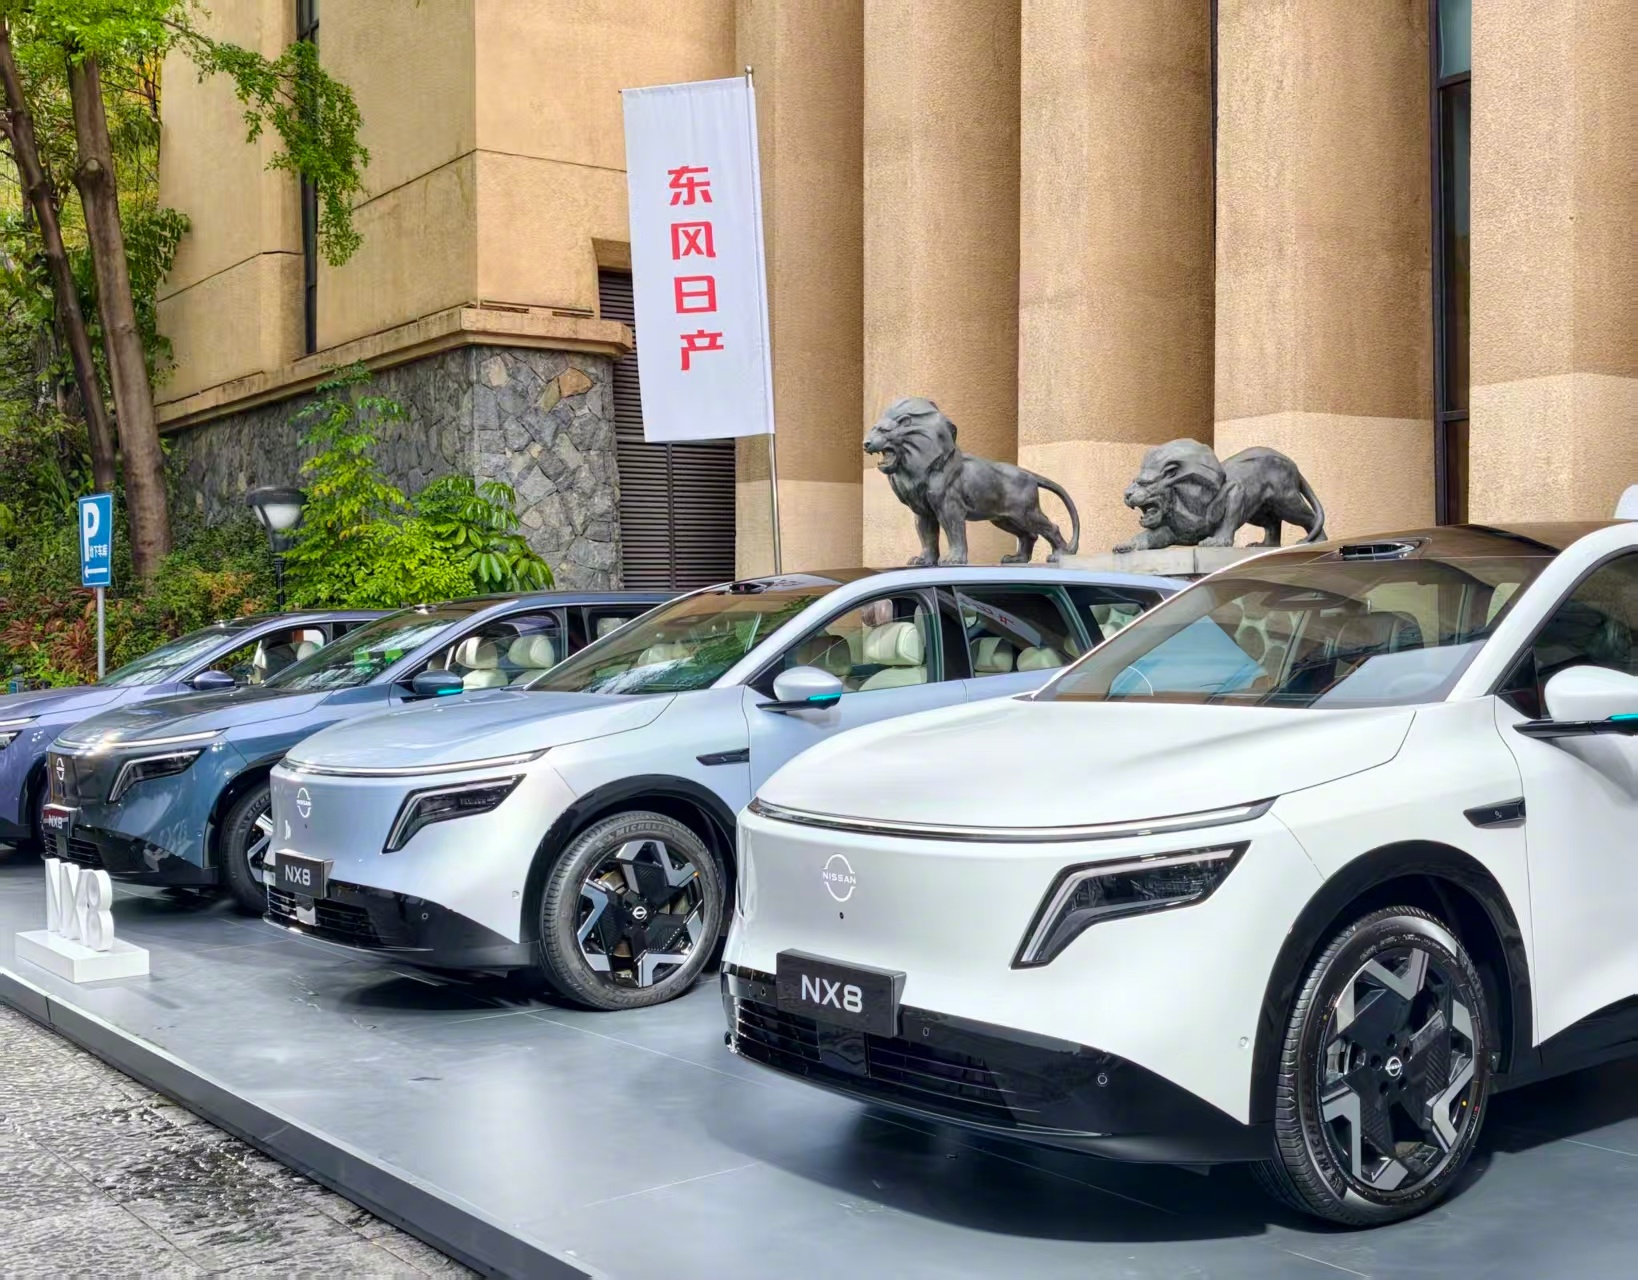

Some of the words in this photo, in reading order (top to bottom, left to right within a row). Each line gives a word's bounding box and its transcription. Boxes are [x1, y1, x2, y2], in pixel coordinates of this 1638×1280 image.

[667, 165, 725, 371] 东风日产
[83, 502, 100, 562] P
[48, 814, 63, 829] NX8
[284, 864, 311, 886] NX8
[822, 871, 856, 884] NISSAN
[45, 858, 114, 952] NX8
[801, 974, 863, 1013] NX8
